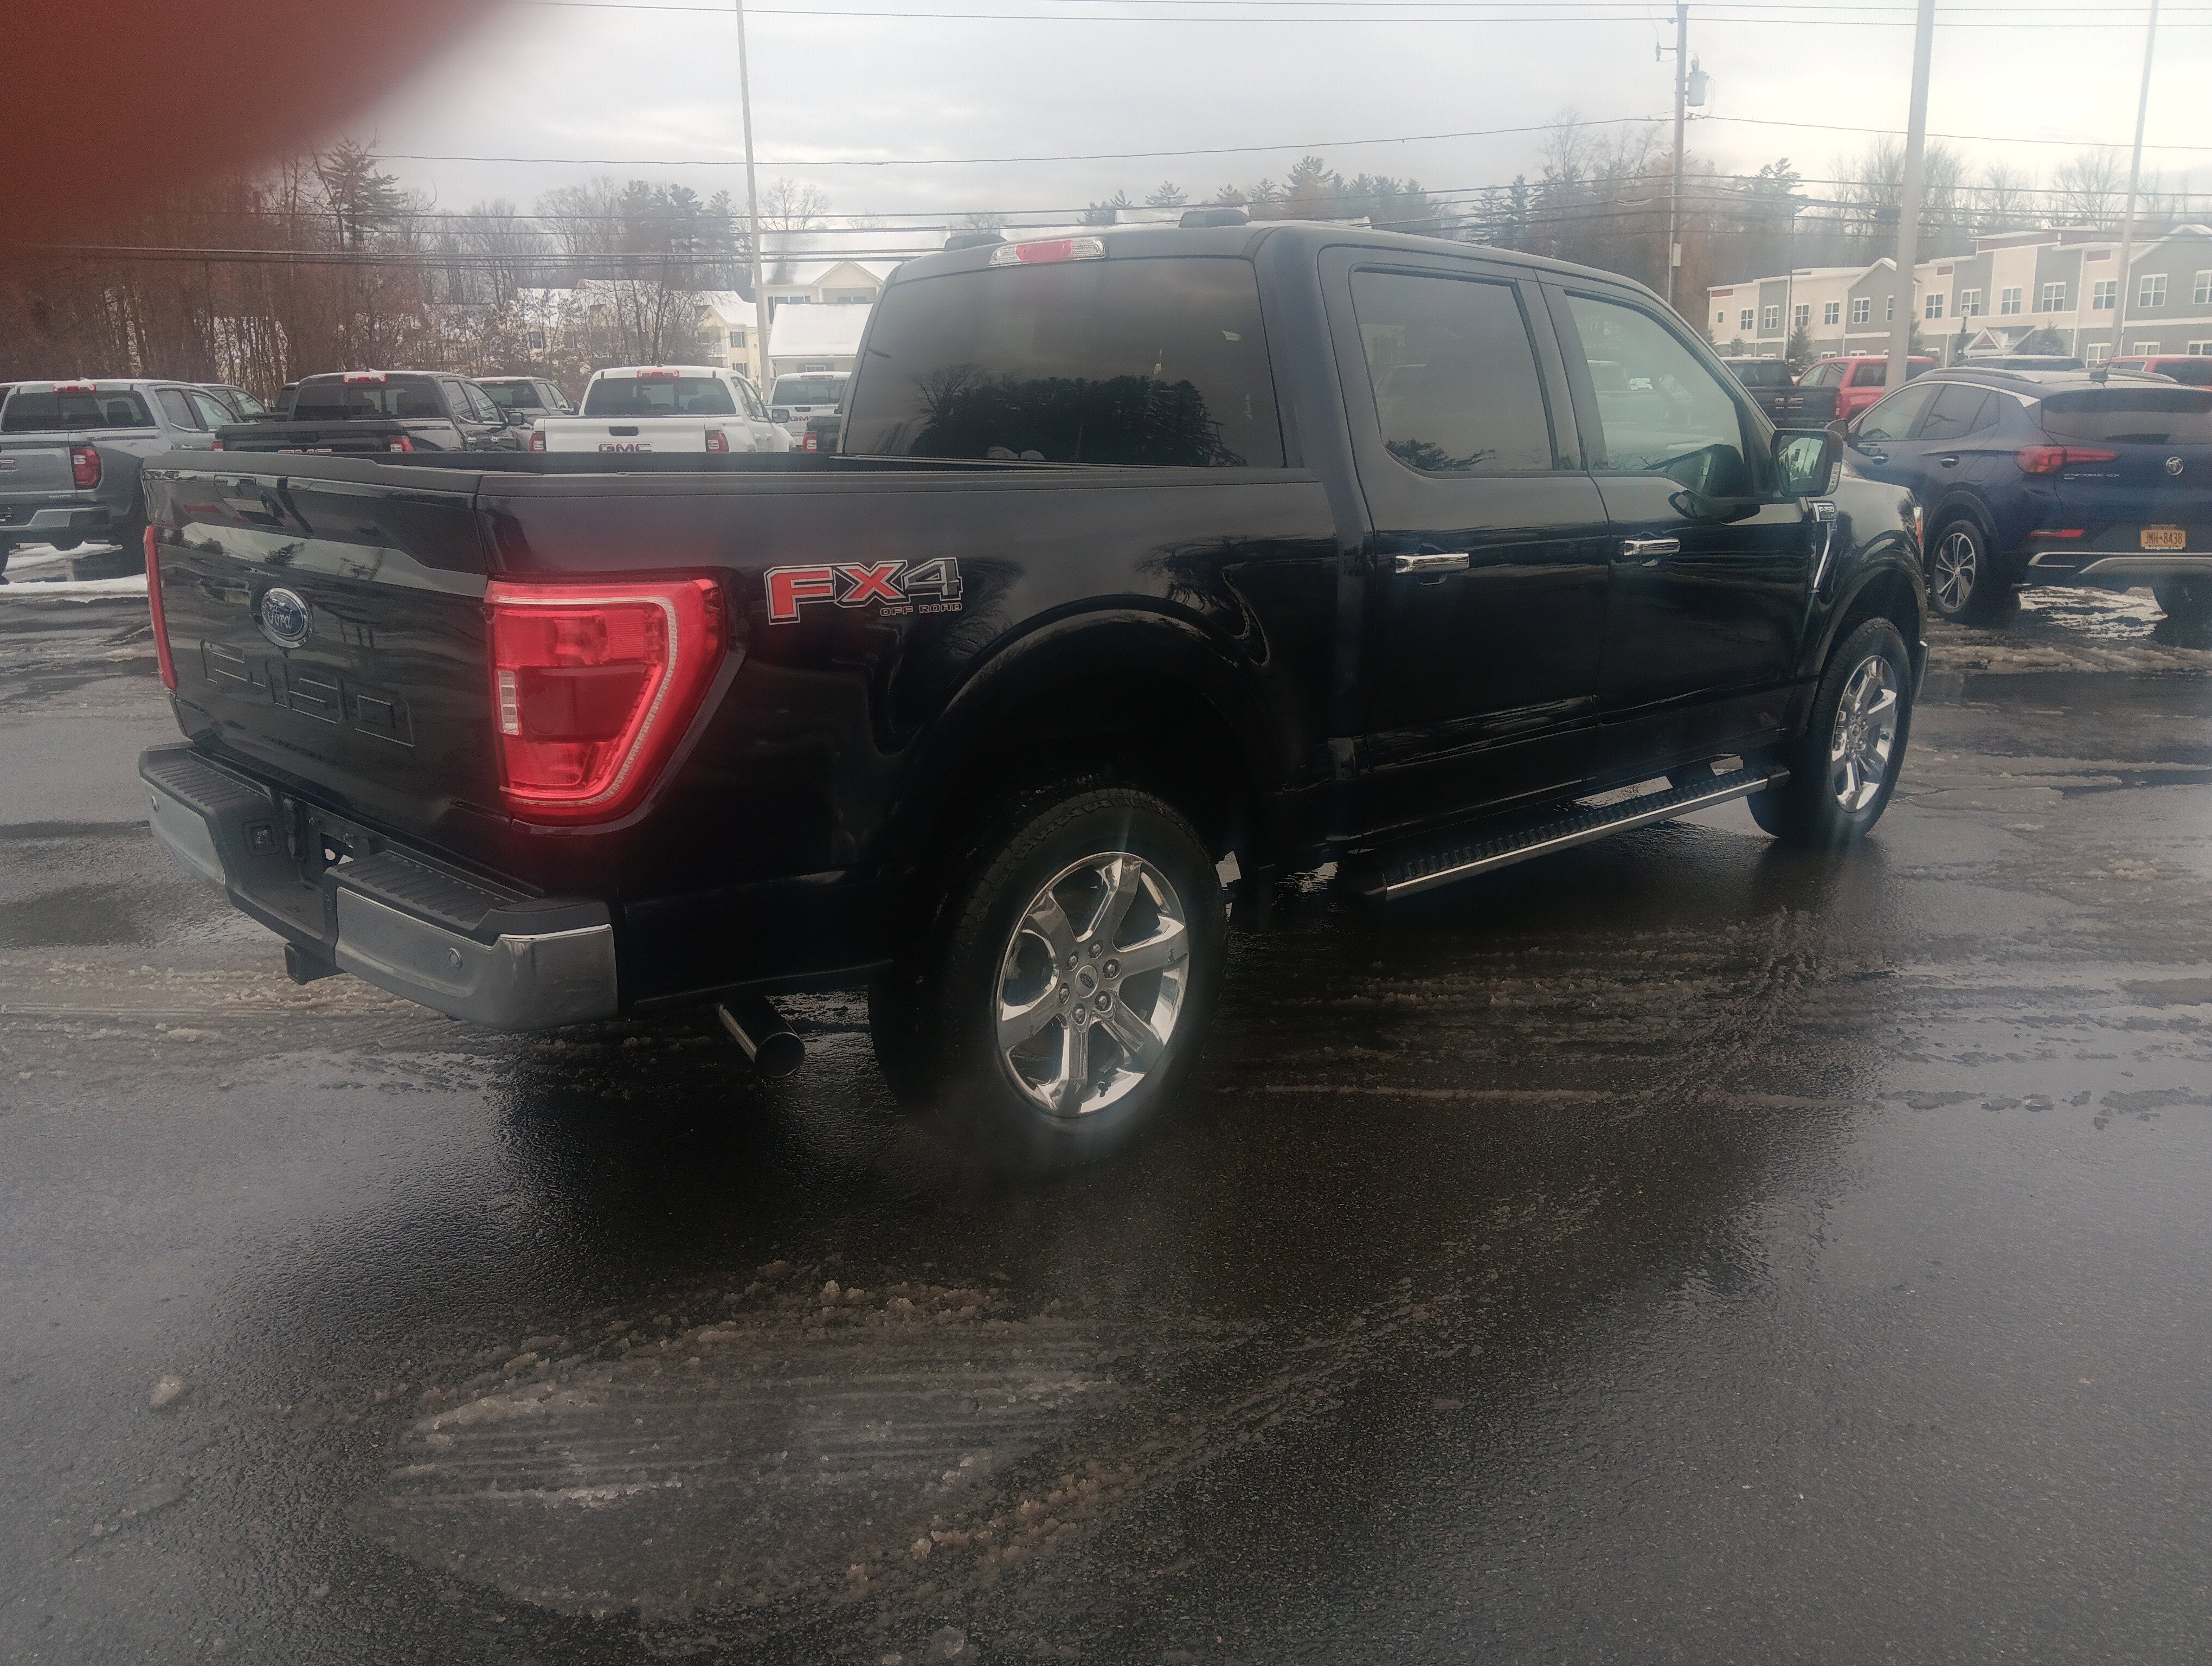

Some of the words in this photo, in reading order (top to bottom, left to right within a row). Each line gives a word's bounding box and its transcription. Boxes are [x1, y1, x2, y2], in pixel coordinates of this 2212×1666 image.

[764, 557, 963, 625] FX4
[265, 598, 293, 629] Ford
[880, 606, 914, 617] OFF
[918, 602, 962, 613] ROAD
